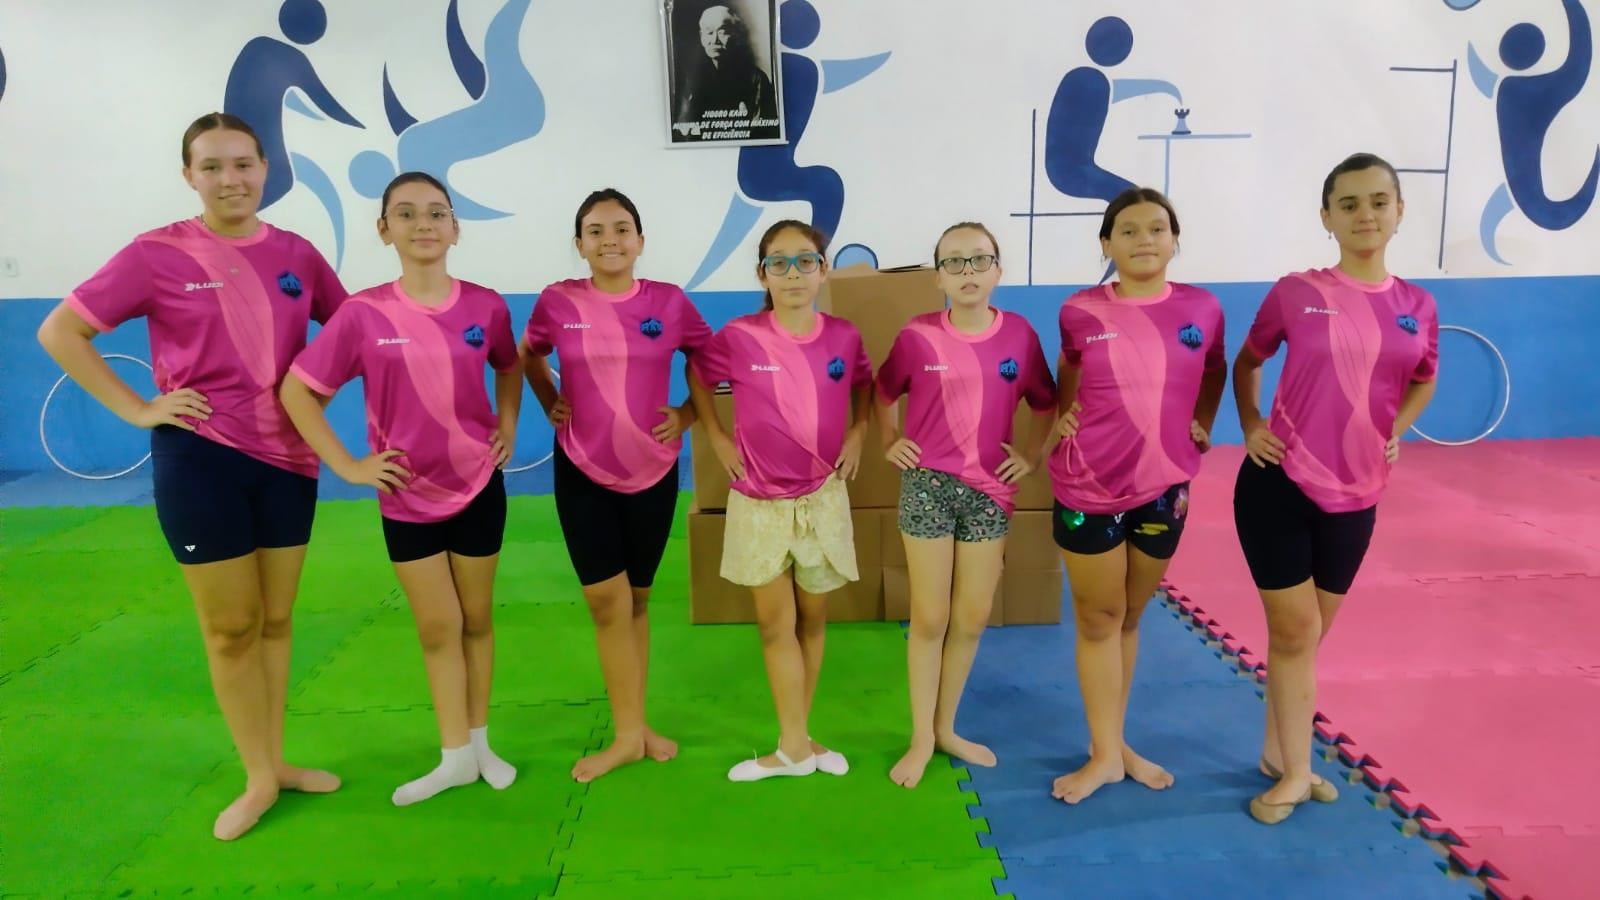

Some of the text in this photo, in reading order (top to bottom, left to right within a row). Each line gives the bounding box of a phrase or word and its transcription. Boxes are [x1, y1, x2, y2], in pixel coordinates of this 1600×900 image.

[700, 121, 710, 129] DE
[711, 120, 733, 130] FORÇA
[734, 119, 750, 128] COM
[750, 117, 779, 127] MÁXIMO
[702, 129, 751, 140] DE EFICIÊNCIA
